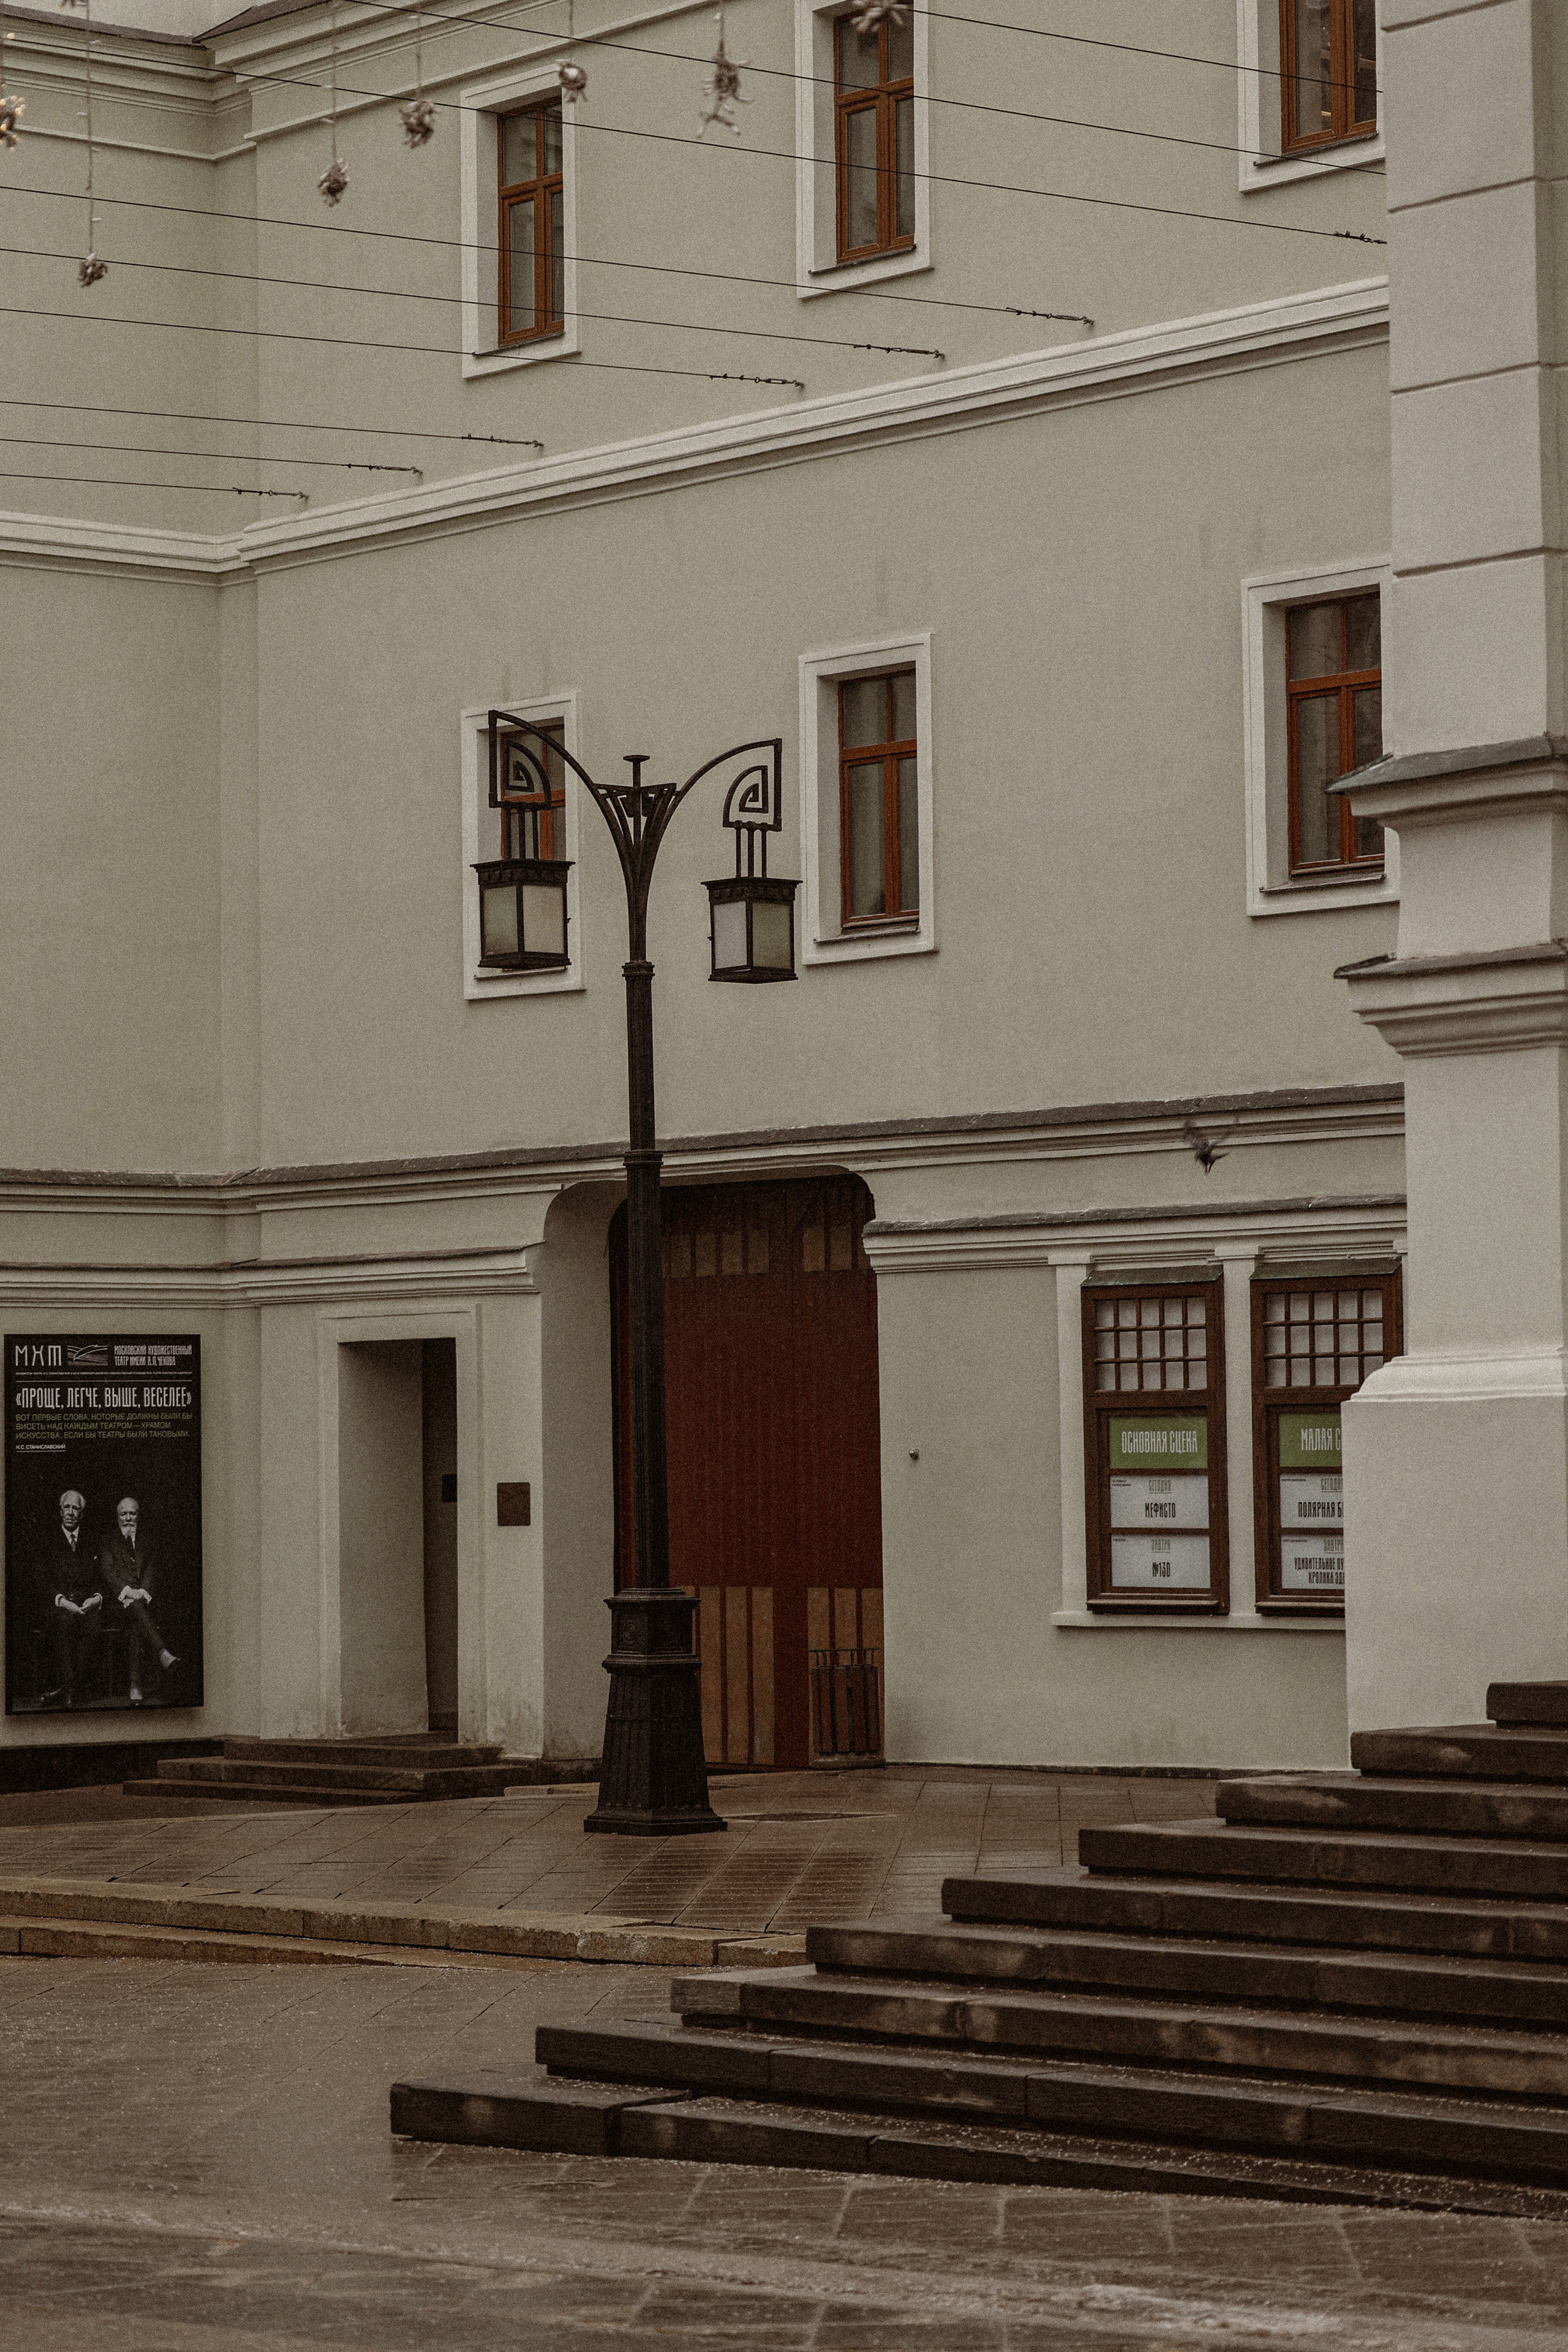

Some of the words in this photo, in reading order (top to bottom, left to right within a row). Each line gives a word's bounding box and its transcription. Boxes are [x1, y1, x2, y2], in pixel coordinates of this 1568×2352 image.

[114, 1344, 147, 1355] МОСКОВСКИЙ
[148, 1344, 192, 1355] ХУДОЖЕСТВЕННЫЙ
[115, 1355, 129, 1366] ТЕАТР
[129, 1355, 146, 1366] ИМЕНИ
[157, 1355, 176, 1366] ЧЕХОВА
[16, 1387, 64, 1409] «ПРОЩЕ,
[67, 1387, 102, 1409] ЛЕГЧЕ,
[105, 1387, 141, 1409] ВЫШЕ,
[143, 1386, 192, 1408] ВЕСЕЛЕЕ»
[64, 1422, 98, 1430] КАЖДЫМ
[1121, 1430, 1167, 1453] ОСНОВНАЯ
[1169, 1430, 1198, 1455] СЦЕНА
[1301, 1428, 1333, 1451] МАЛАЯ
[1148, 1480, 1172, 1492] СЕГОДНЯ
[1145, 1502, 1176, 1518] МЕФИСТО
[1298, 1502, 1336, 1518] ПОЛЯРНАЯ
[1152, 1539, 1171, 1551] ЗАВТРА
[1294, 1557, 1335, 1570] УДИВИТЕЛЬНОЕ
[1308, 1572, 1334, 1584] КРОЛИКА
